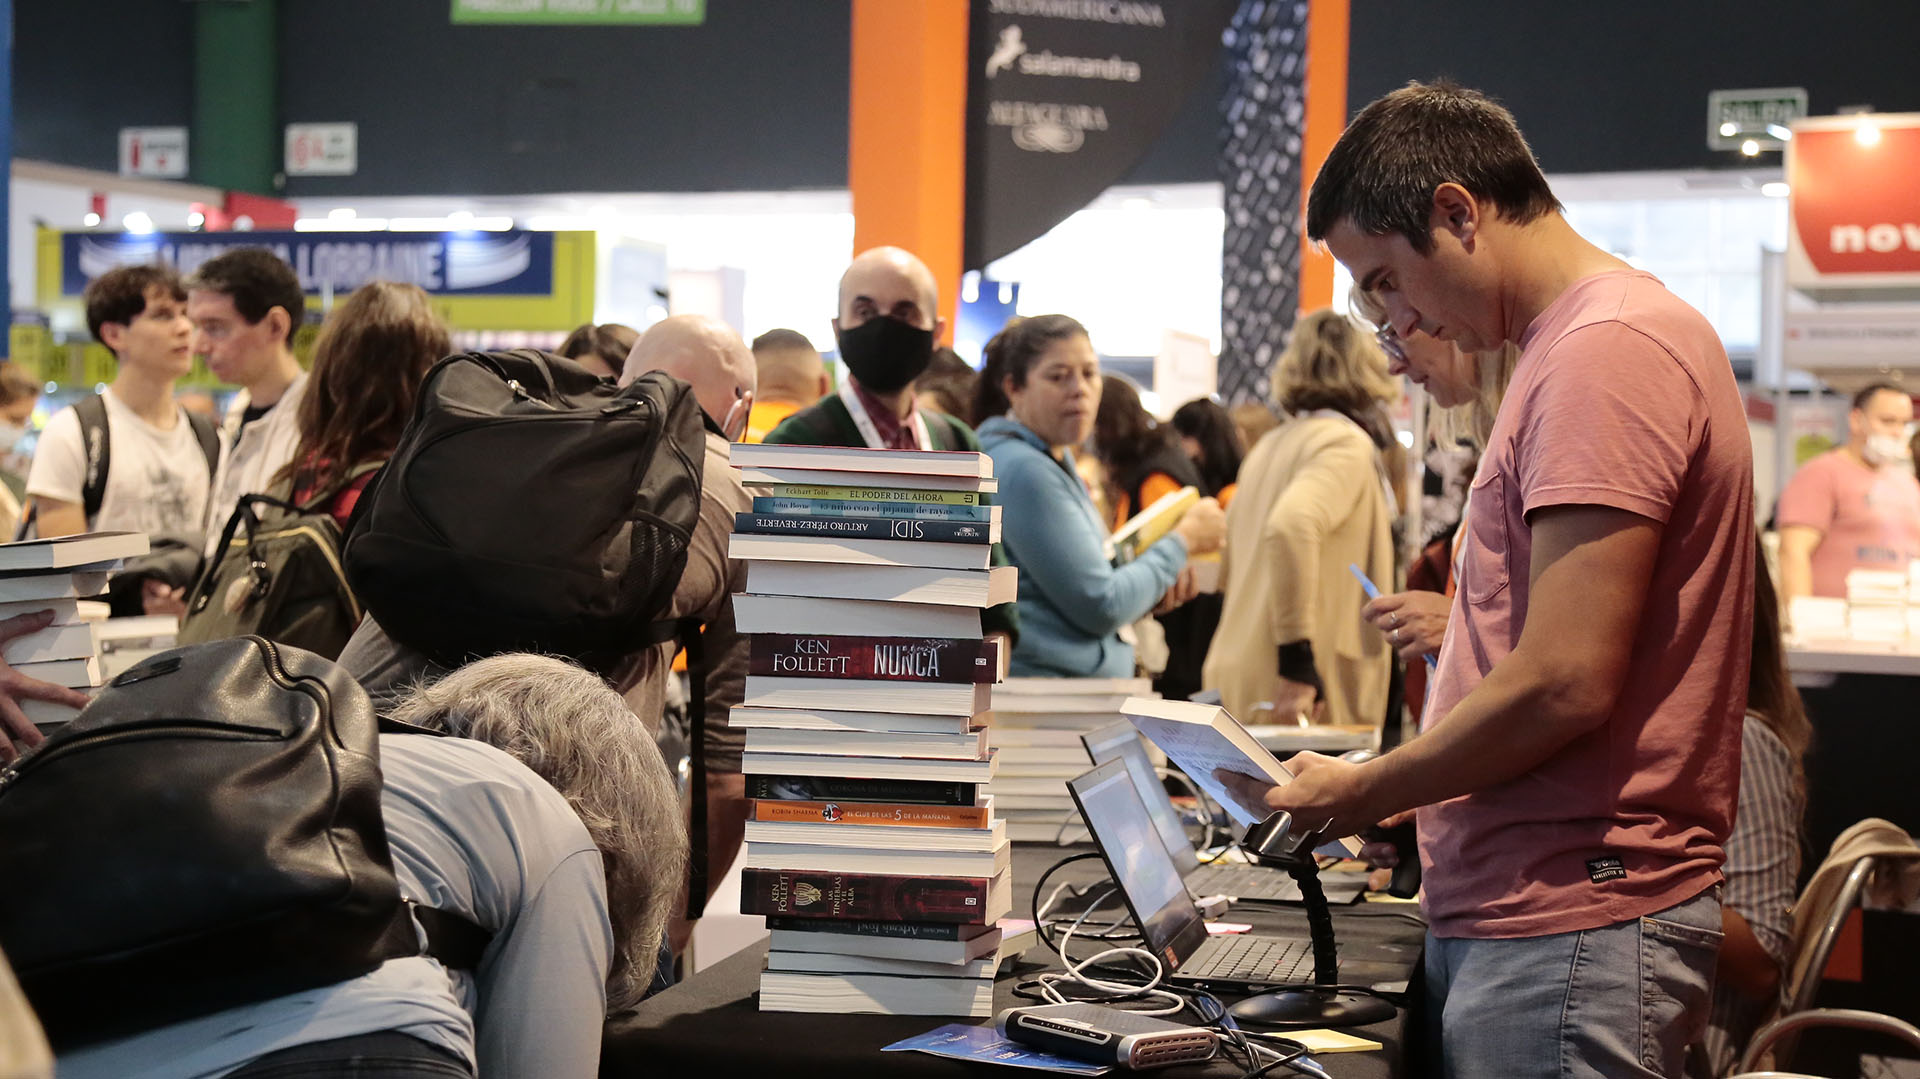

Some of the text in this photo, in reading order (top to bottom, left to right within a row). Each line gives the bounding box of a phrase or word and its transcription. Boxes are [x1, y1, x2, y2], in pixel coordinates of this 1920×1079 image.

[1018, 50, 1142, 82] salamandra
[785, 487, 944, 502] Eckhart Tolle EL PODER DEL AHORA
[772, 501, 788, 509] John
[831, 502, 852, 511] niño
[853, 504, 867, 512] con
[871, 504, 880, 512] el
[916, 505, 925, 514] de
[756, 518, 869, 531] ARTURO PÉREZ-REVERTE
[890, 520, 924, 539] SIDI
[795, 639, 830, 654] KEN
[773, 653, 850, 674] FOLLETT
[873, 644, 940, 677] NUNCA
[894, 809, 902, 821] 5
[921, 812, 951, 821] MAÑANA
[771, 882, 779, 902] KEN
[778, 874, 789, 913] FOLLETT
[833, 875, 842, 915] TINIEBLAS
